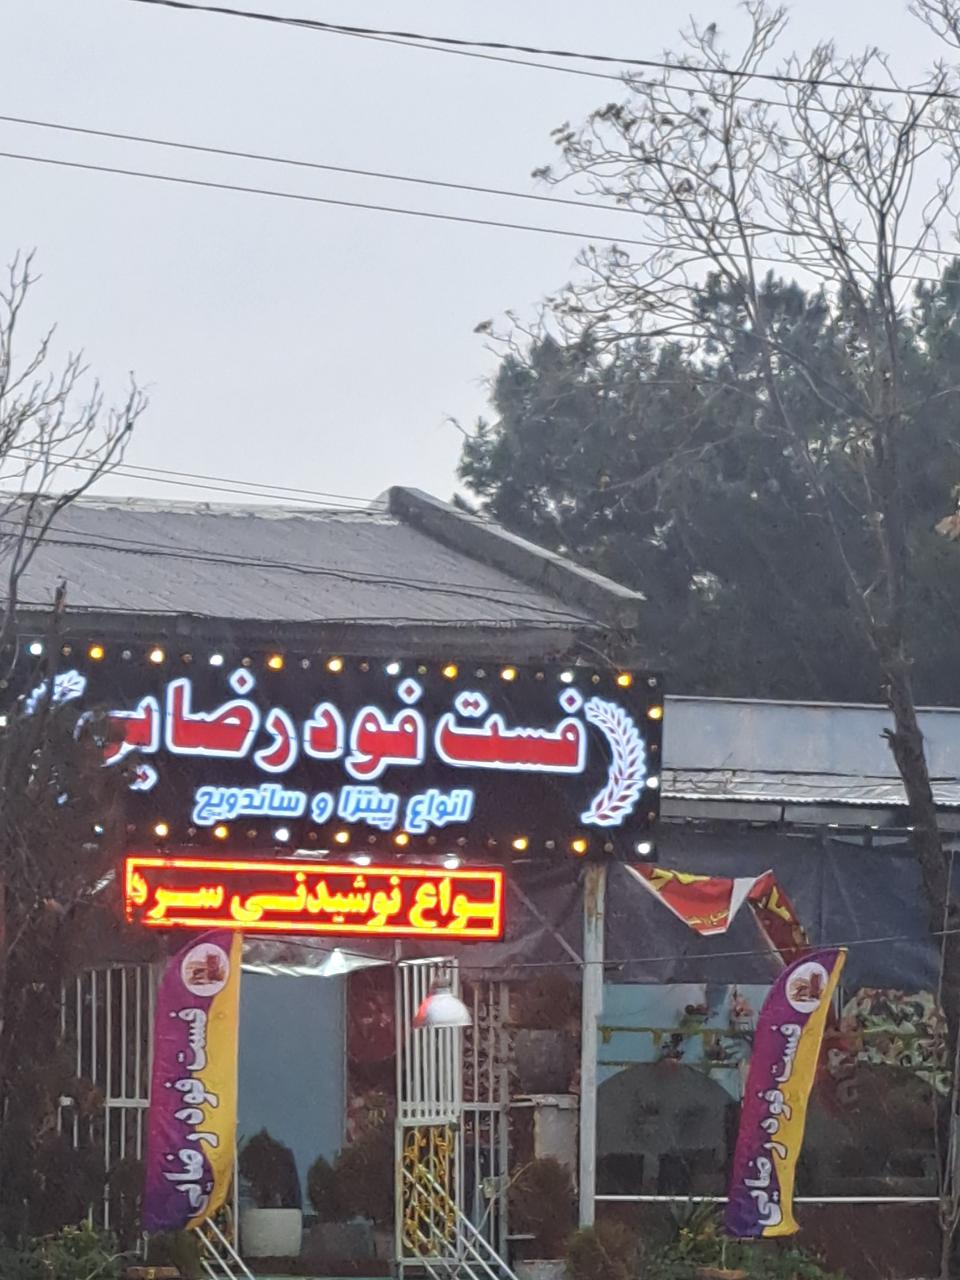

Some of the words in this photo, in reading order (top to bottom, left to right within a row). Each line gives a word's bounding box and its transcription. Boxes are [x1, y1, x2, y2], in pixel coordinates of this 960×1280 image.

[303, 677, 425, 780] فود
[434, 687, 589, 774] فست
[193, 783, 306, 825] ساندویچ
[311, 792, 333, 823] و
[338, 785, 399, 831] پیتزا
[406, 789, 473, 833] انواع
[230, 871, 402, 928] نوشیدنی
[169, 1008, 207, 1071] فست
[770, 1023, 802, 1083] فست
[164, 1077, 219, 1128] فود
[757, 1089, 792, 1135] فود
[743, 1141, 786, 1226] رضایی
